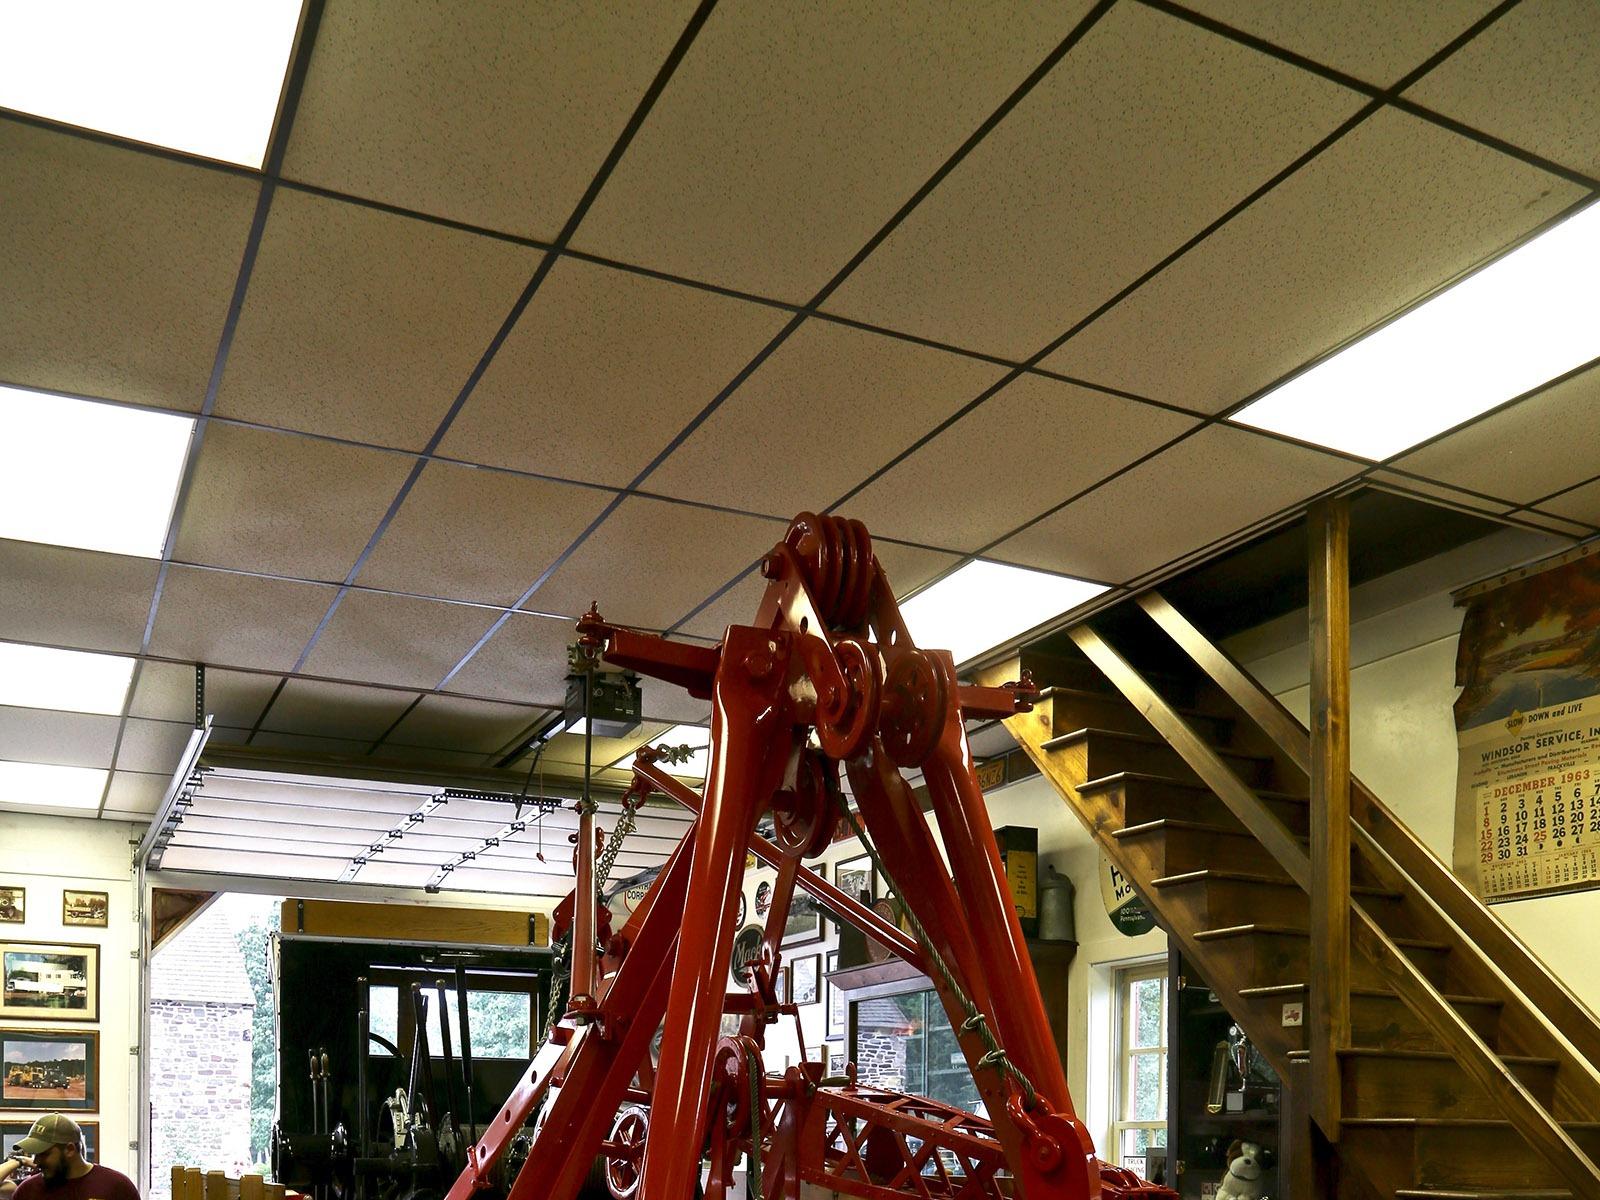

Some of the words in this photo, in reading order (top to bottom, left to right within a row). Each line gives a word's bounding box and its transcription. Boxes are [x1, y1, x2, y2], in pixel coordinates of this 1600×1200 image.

[1508, 717, 1524, 729] SLOW
[1528, 712, 1549, 723] DOWN
[1552, 706, 1566, 718] and
[1568, 703, 1583, 714] LIVE
[1482, 742, 1530, 762] WINDSOR
[1536, 730, 1585, 748] SERVICE,
[1494, 776, 1555, 798] DECEMBER
[1561, 770, 1590, 784] 1963
[1484, 807, 1488, 816] 1
[1501, 803, 1506, 812] 2
[1519, 799, 1524, 808] 3
[1536, 796, 1543, 805] 4
[1555, 791, 1561, 801] 5
[1574, 788, 1580, 798] 6
[1484, 818, 1489, 828] 8
[1501, 815, 1507, 824] 9
[1516, 810, 1527, 821] 10
[1535, 807, 1545, 817] 11
[1552, 803, 1564, 814] 12
[1571, 800, 1583, 810] 13
[1481, 830, 1492, 840] 15
[1498, 826, 1509, 836] 16
[1516, 822, 1527, 833] 17
[1534, 819, 1546, 830] 18
[1553, 816, 1564, 826] 19
[1571, 812, 1583, 823] 20
[1481, 841, 1492, 851] 22
[1498, 838, 1510, 848] 23
[1515, 834, 1528, 845] 24
[1534, 831, 1546, 841] 25
[1553, 827, 1566, 838] 26
[1571, 824, 1584, 835] 27
[1481, 852, 1493, 863] 29
[1498, 849, 1510, 860] 30
[1517, 846, 1528, 856] 31
